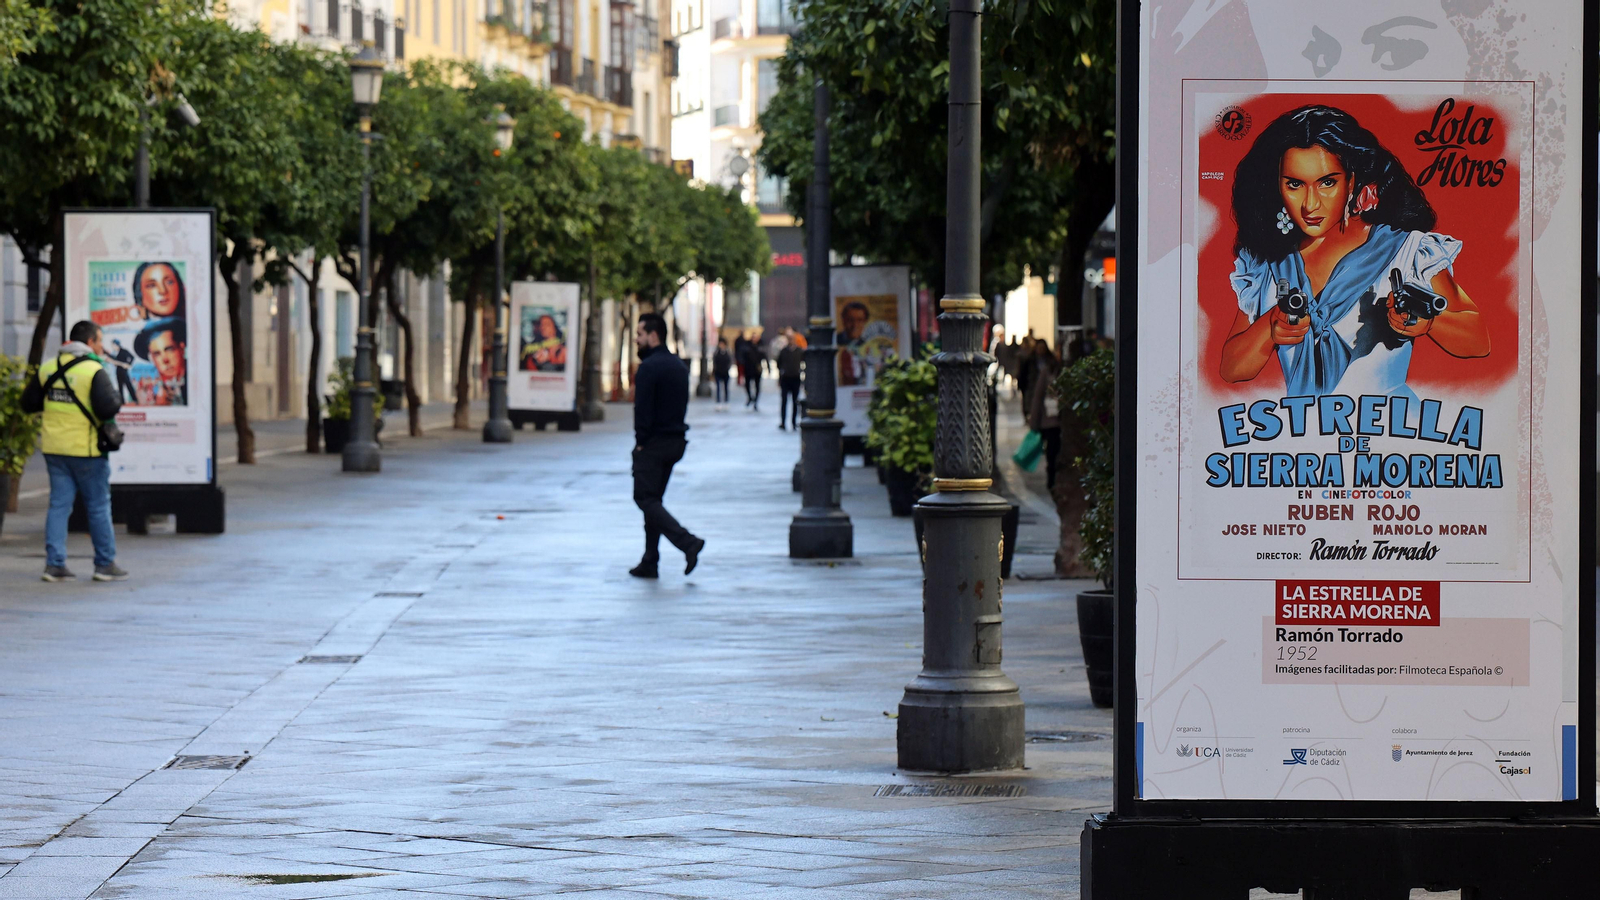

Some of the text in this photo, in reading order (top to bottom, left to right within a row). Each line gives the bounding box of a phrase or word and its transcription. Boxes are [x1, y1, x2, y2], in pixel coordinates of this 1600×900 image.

[1414, 97, 1493, 146] Lola
[1416, 145, 1507, 188] Flores
[1217, 394, 1484, 451] ESTRELLA
[1338, 435, 1371, 453] DE
[1205, 452, 1503, 488] SIERRA MORENA
[1298, 490, 1412, 499] EN CINEFOTOCOLOR
[1288, 504, 1420, 521] RUBEN ROJO
[1221, 524, 1306, 536] JOSE NIETO
[1373, 524, 1487, 536] MANOLO MORAN
[1256, 538, 1440, 561] DIRECTOR: Ramón Torrado
[1282, 585, 1422, 602] LA ESTRELLA DE
[1282, 604, 1432, 620] SIERRA MORENA
[1275, 627, 1403, 643] Ramón Torrado
[1276, 645, 1318, 661] 1952
[1275, 664, 1322, 675] Imágenes
[1324, 664, 1375, 675] facilitadas
[1377, 666, 1397, 676] por:
[1399, 665, 1447, 675] Filmoteca
[1449, 665, 1493, 677] Española
[1195, 747, 1221, 758] UCA
[1310, 748, 1347, 757] Diputación
[1405, 749, 1448, 757] Ayuntamiento
[1499, 765, 1531, 777] Cajasol
